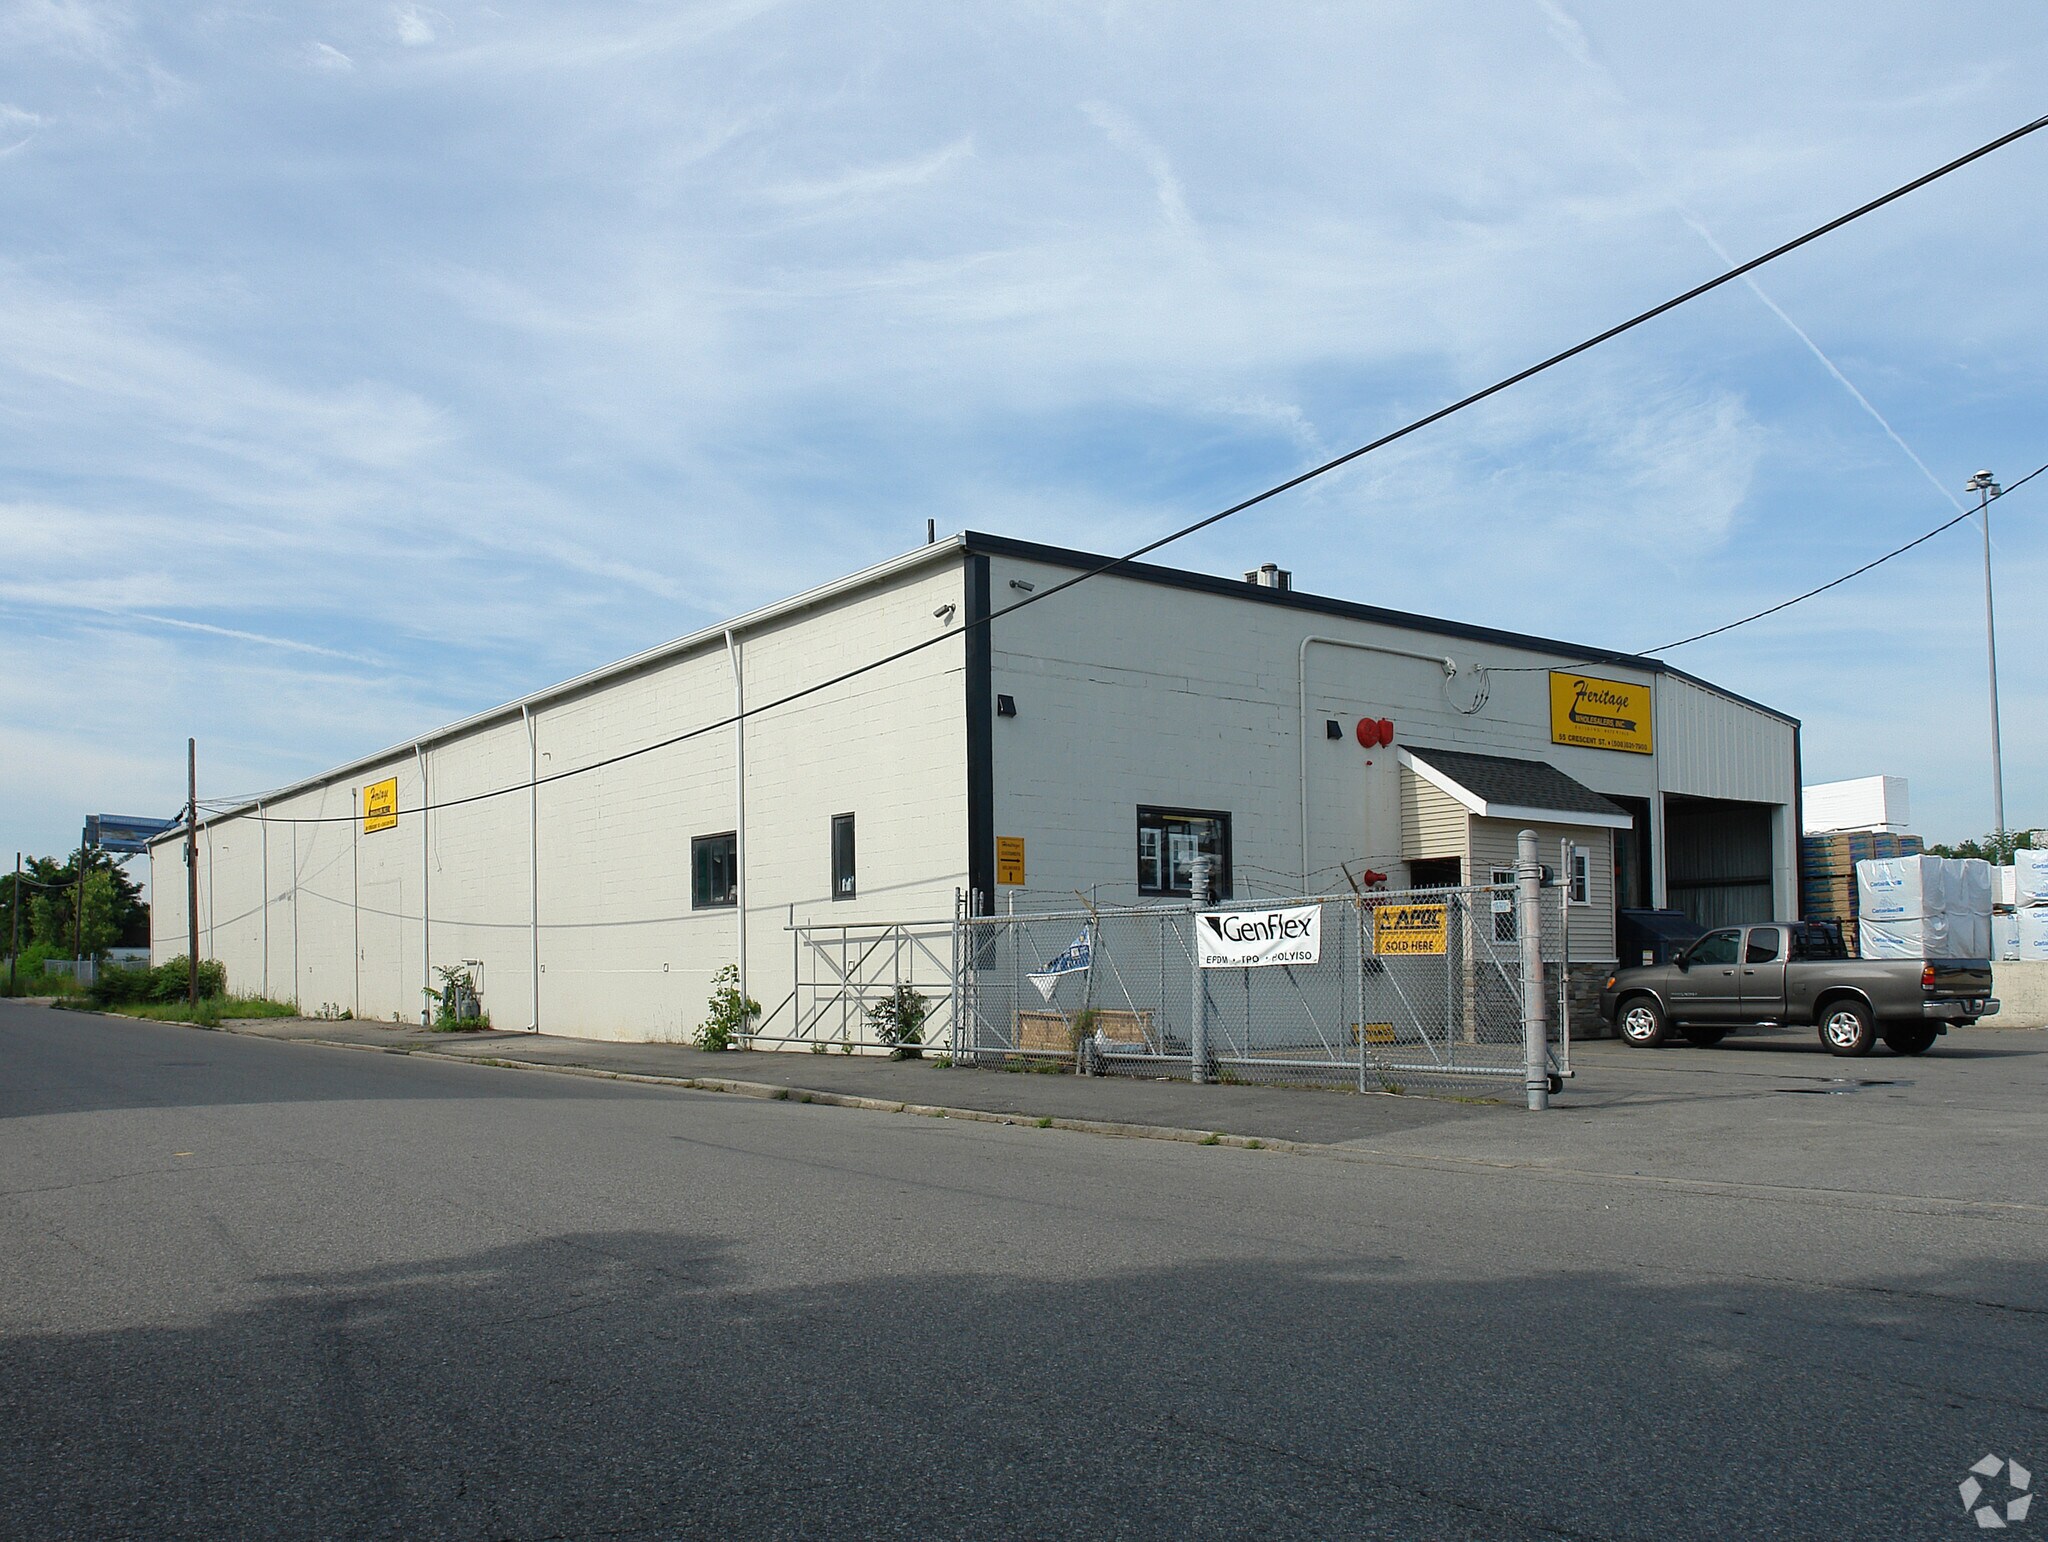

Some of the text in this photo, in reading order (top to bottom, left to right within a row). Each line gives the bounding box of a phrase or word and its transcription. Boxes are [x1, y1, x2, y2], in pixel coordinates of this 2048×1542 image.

[1573, 680, 1629, 713] Heritage
[1568, 734, 1597, 745] CRESCENT
[1223, 914, 1311, 942] GenFlex
[1385, 940, 1434, 951] SOLD HERE
[1206, 951, 1312, 964] EPDM TPO POLYISO
